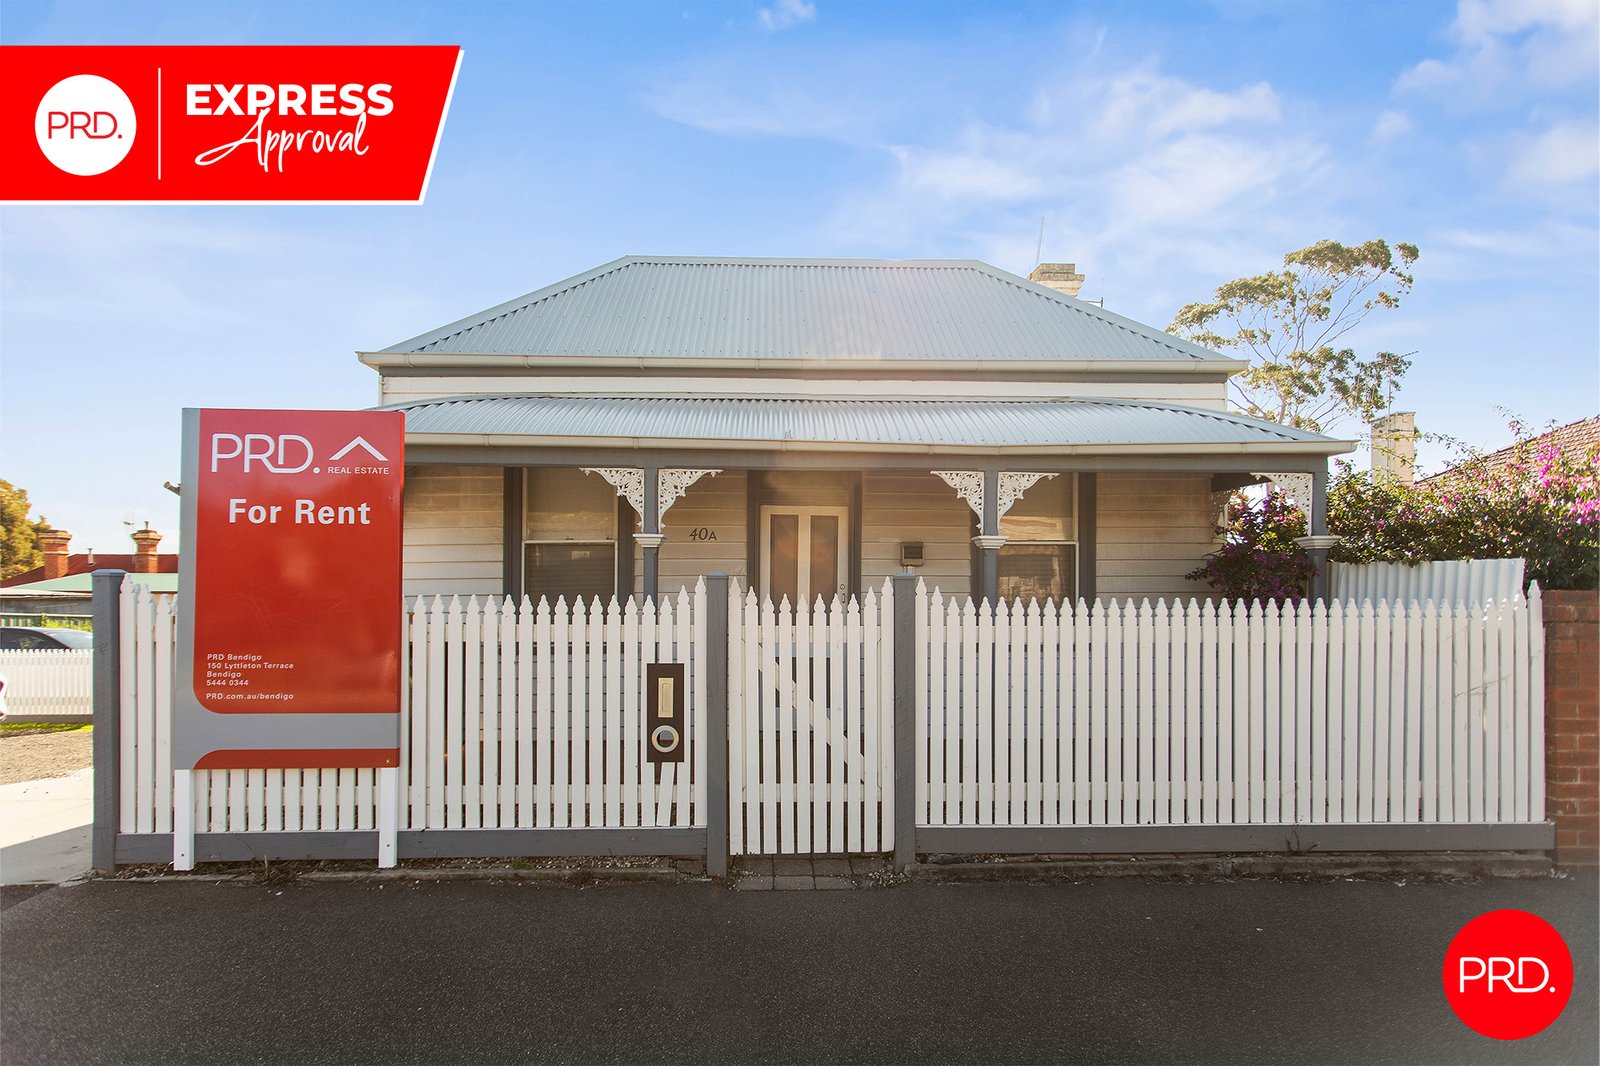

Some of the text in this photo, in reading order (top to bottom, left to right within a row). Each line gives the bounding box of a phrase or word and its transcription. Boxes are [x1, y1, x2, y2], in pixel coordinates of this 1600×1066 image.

[327, 466, 389, 475] REAL ESTATE
[228, 498, 371, 525] For Rent
[689, 527, 717, 541] 40A
[207, 653, 224, 661] PRD
[224, 662, 261, 670] Lyttleton
